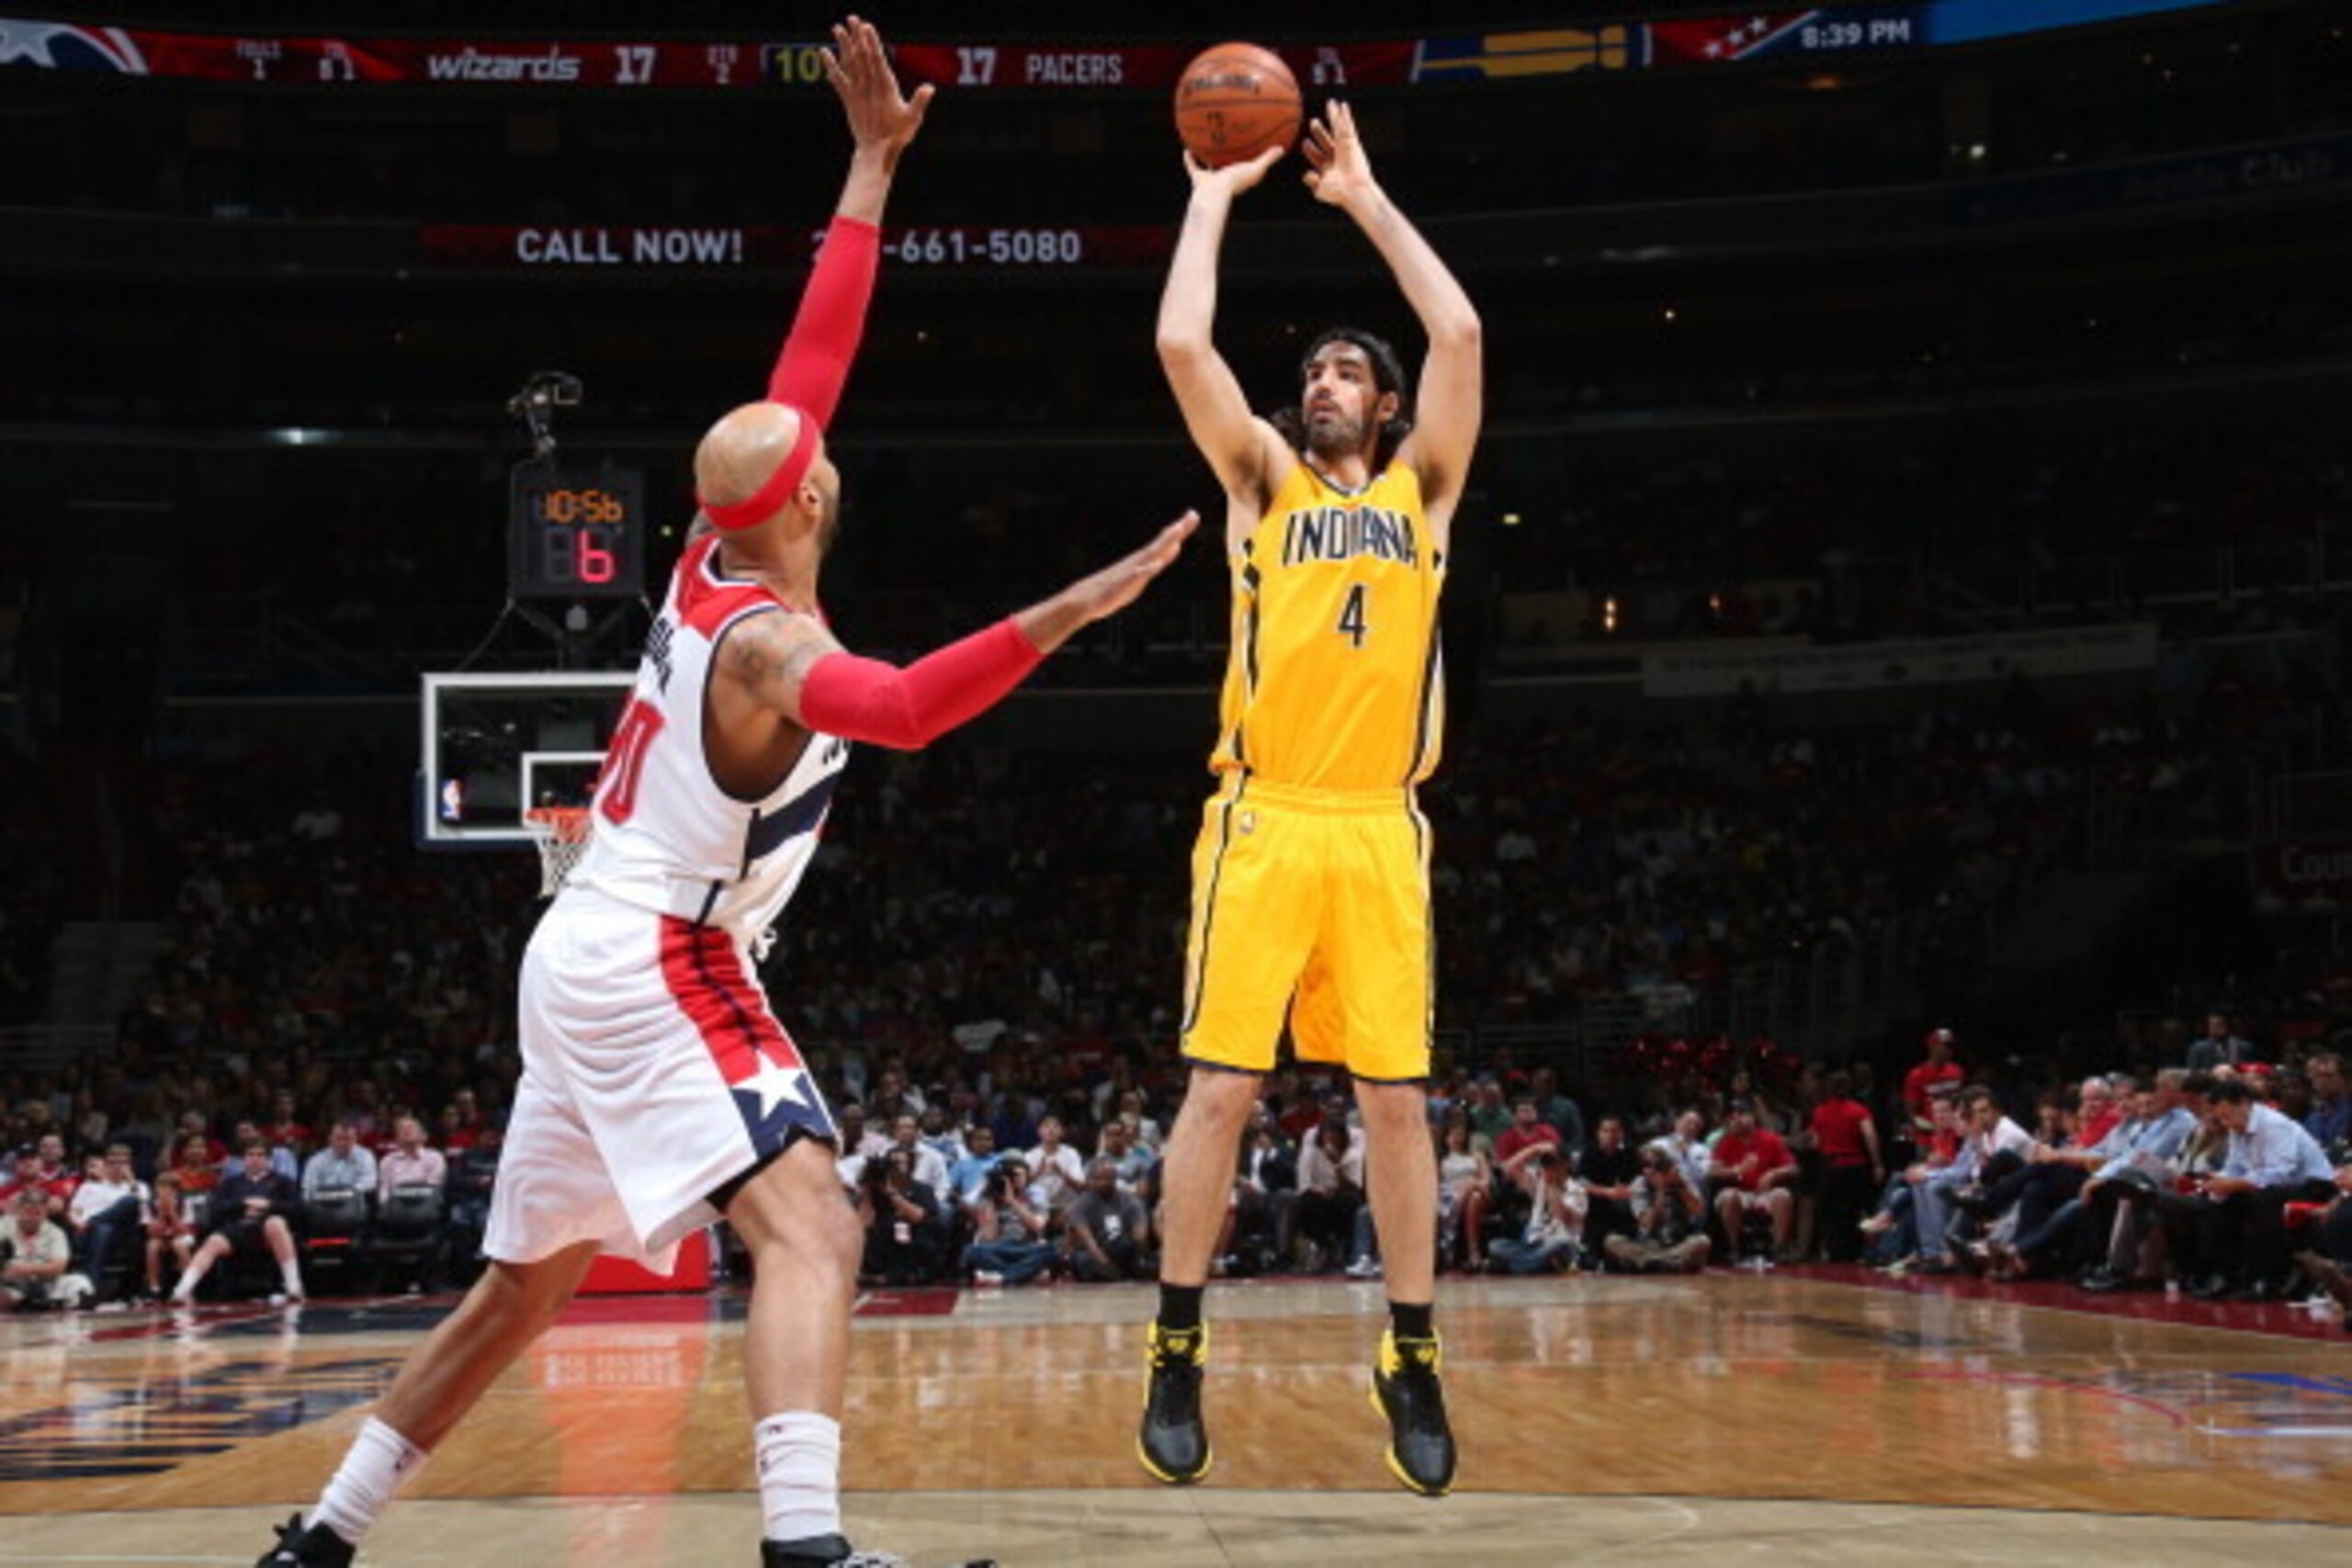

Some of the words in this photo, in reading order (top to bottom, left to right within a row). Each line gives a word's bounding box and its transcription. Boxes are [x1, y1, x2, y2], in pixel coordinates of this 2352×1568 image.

[1801, 23, 1862, 49] 8:39
[1871, 18, 1910, 44] PM
[427, 44, 583, 81] wizards
[615, 46, 656, 84] 17
[956, 48, 997, 85] 17
[1025, 54, 1123, 84] PACERS
[516, 229, 622, 264] CALL
[633, 229, 743, 264] NOW!
[1282, 505, 1419, 570] INDIANA
[579, 530, 615, 584] 6
[1338, 581, 1368, 649] 4
